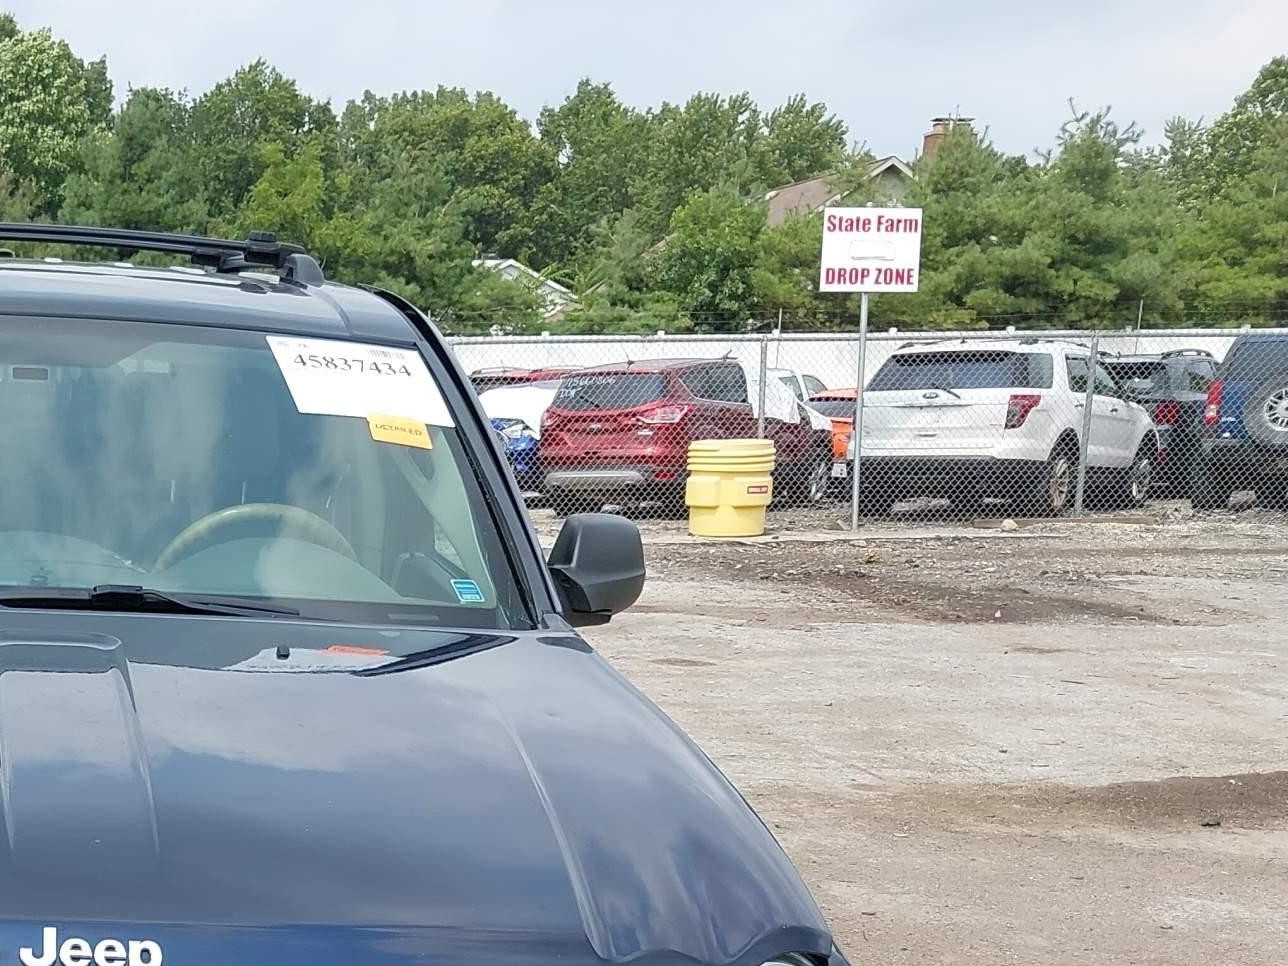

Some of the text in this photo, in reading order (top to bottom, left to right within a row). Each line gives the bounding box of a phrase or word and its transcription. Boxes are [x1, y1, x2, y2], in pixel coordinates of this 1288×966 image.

[827, 214, 919, 233] State Farm
[825, 267, 915, 285] DROP ZONE
[293, 353, 412, 377] 45837434
